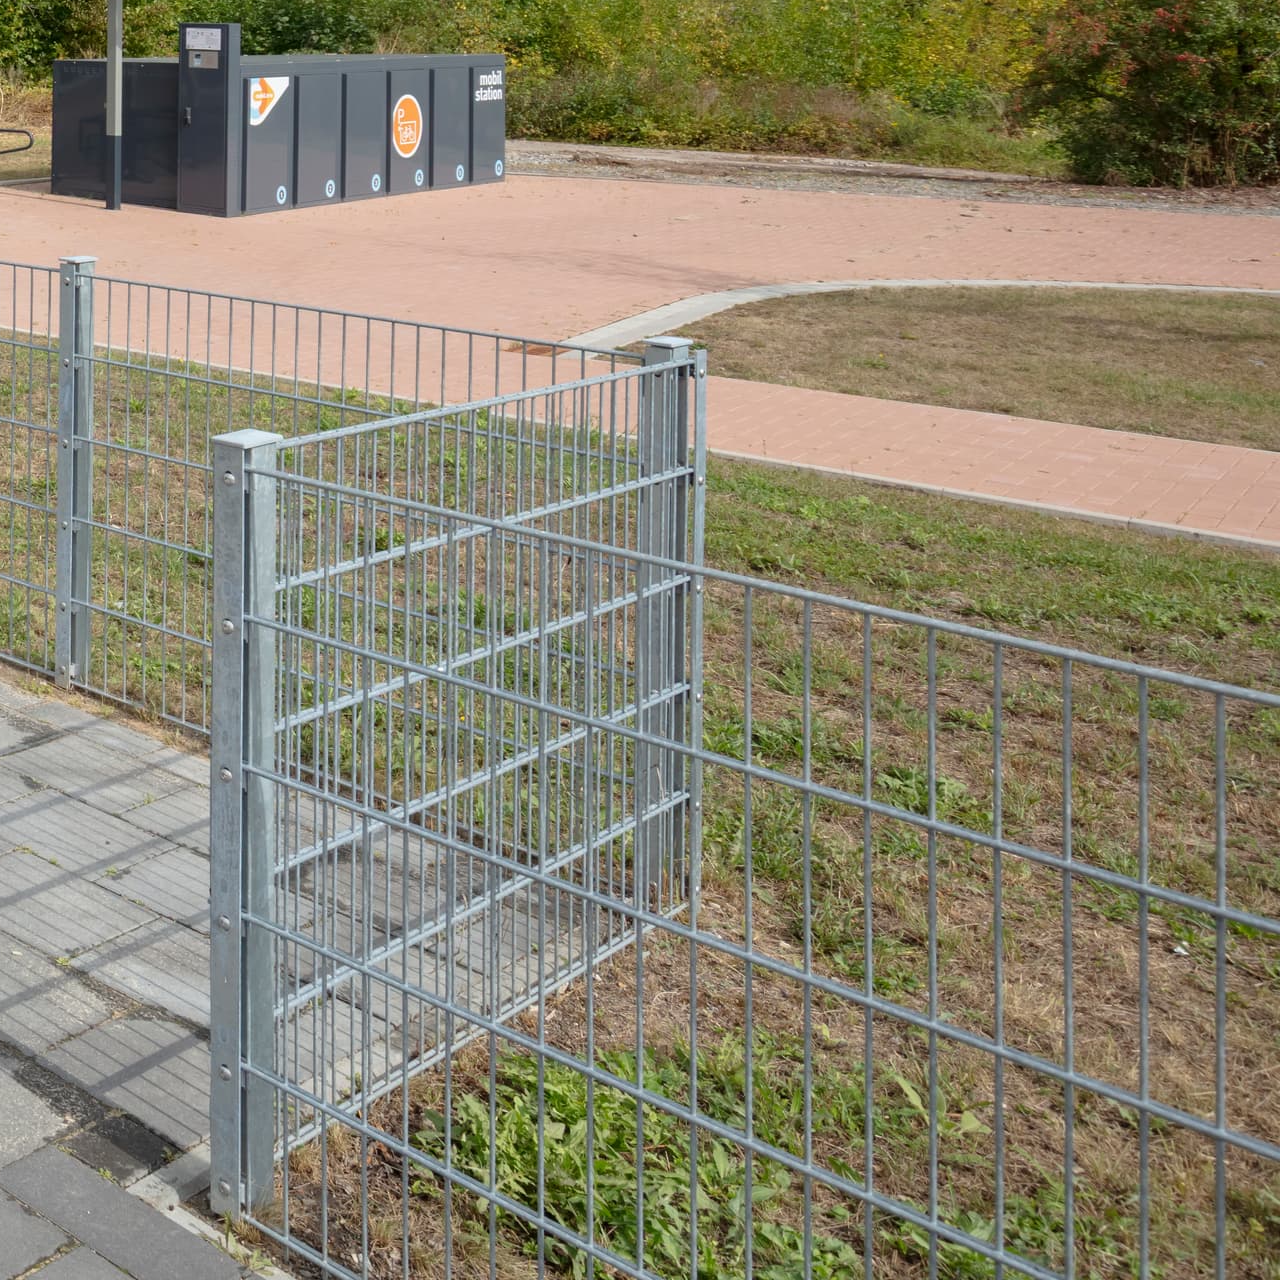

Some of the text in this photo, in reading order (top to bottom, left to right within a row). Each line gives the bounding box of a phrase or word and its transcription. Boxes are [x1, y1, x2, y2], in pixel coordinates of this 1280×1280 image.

[479, 70, 503, 86] mobil
[474, 86, 503, 102] station
[397, 108, 405, 124] P
